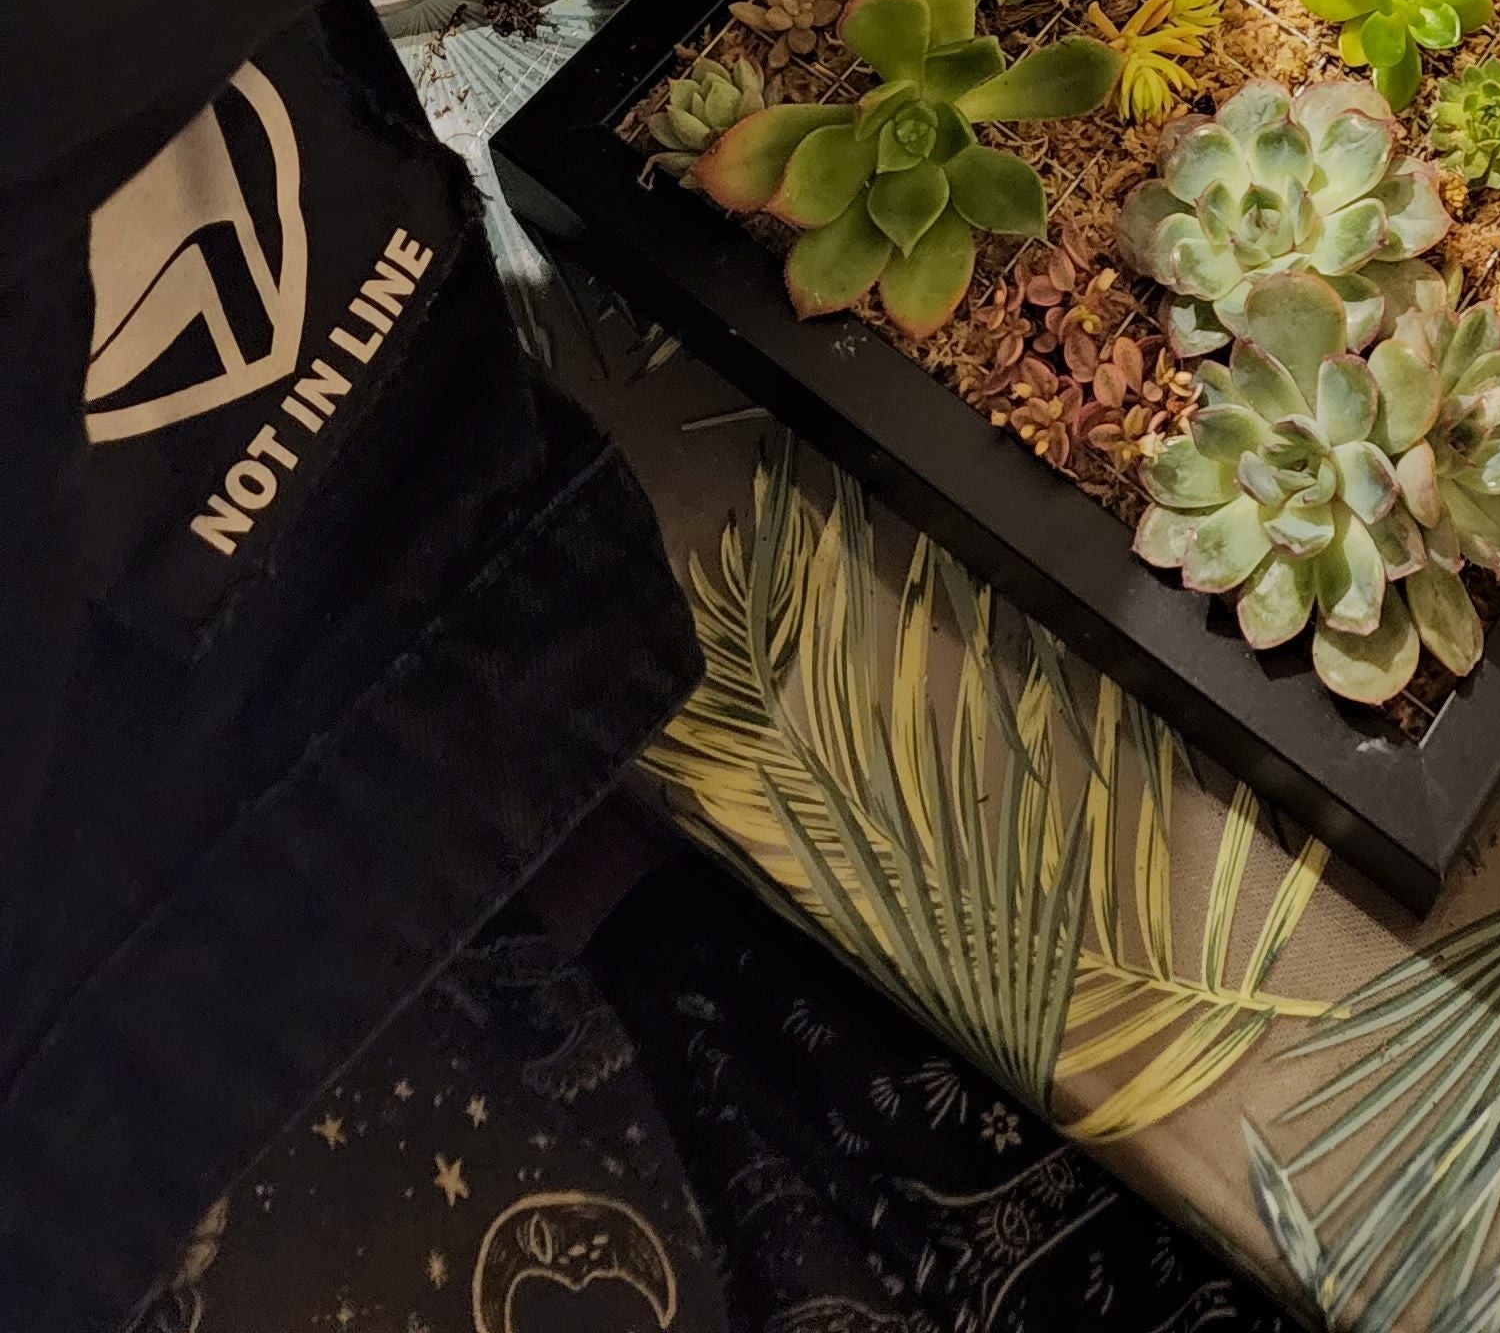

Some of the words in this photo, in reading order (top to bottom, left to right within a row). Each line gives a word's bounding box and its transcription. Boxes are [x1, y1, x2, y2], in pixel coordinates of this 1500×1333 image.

[189, 424, 299, 557] NOT
[280, 358, 353, 434] IN
[328, 227, 434, 364] LINE
